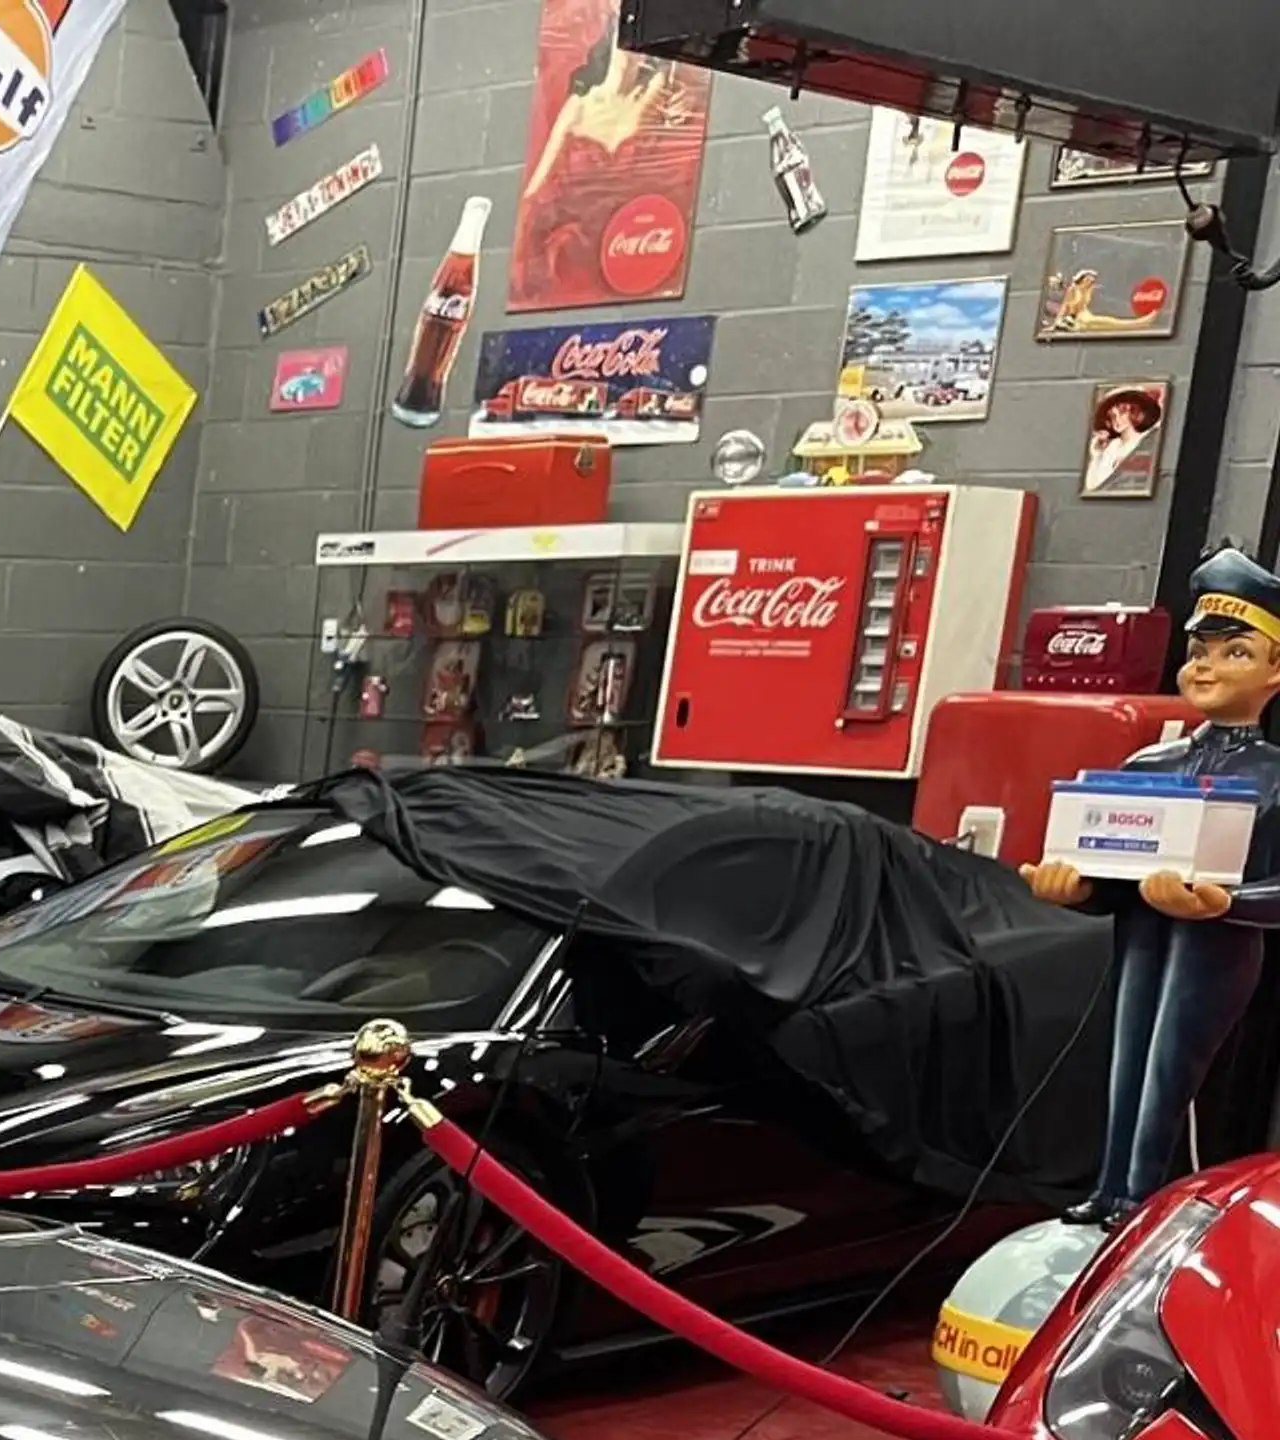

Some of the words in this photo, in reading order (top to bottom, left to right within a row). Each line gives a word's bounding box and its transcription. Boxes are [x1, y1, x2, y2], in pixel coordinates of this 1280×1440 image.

[552, 327, 669, 379] Coca-Cola
[67, 333, 158, 442] MANN
[51, 363, 140, 472] FILTER
[748, 558, 798, 573] TRINK
[692, 575, 848, 629] Coca-Cola
[1107, 812, 1154, 828] BOSCH
[958, 1330, 980, 1362] in
